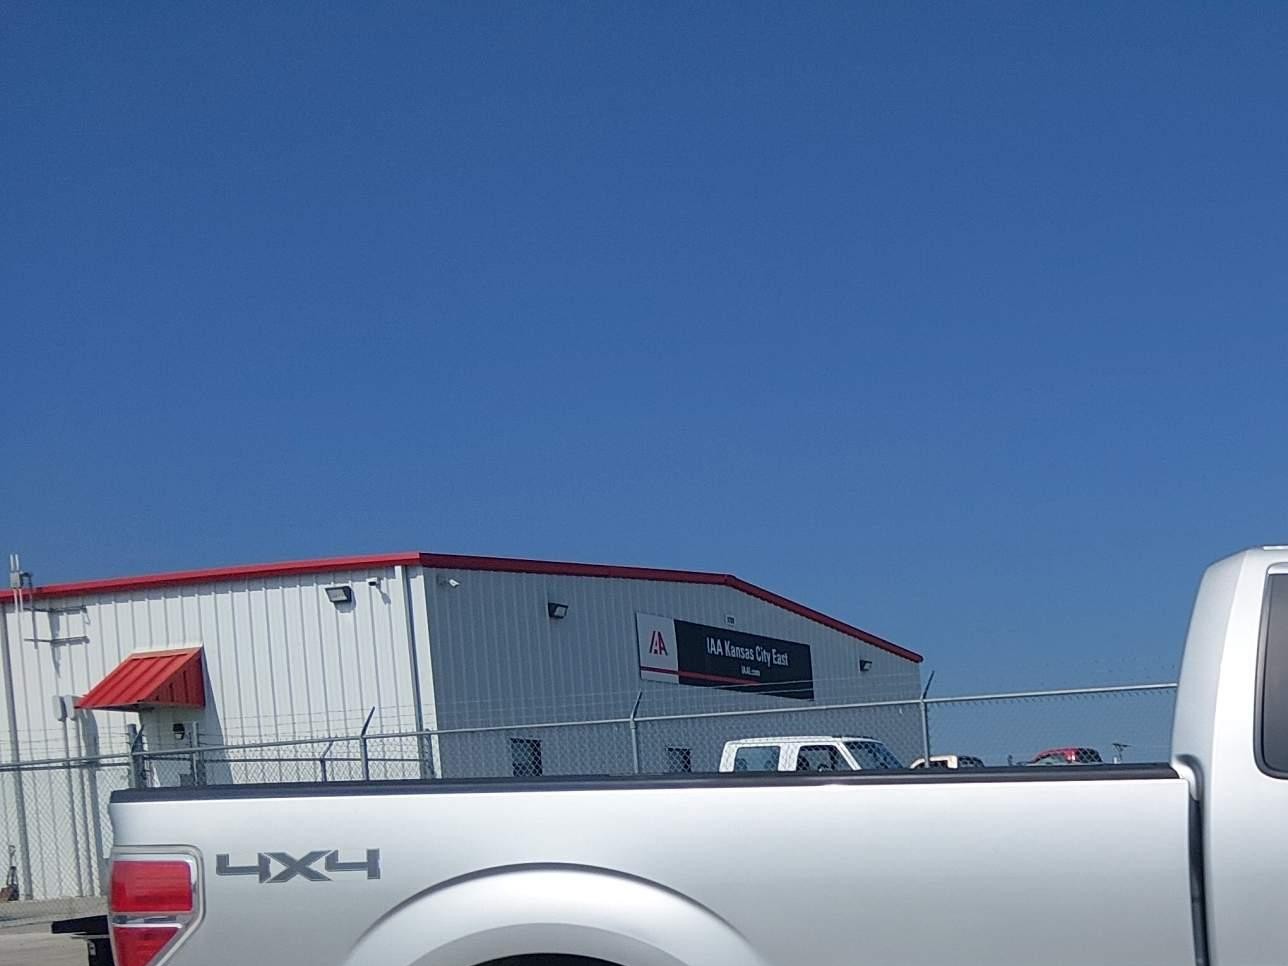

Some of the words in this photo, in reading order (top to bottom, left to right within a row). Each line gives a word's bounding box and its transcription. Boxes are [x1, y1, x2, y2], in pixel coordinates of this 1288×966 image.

[706, 637, 724, 656] IAA
[724, 640, 755, 661] Kansas
[755, 646, 771, 667] City
[771, 648, 789, 667] East
